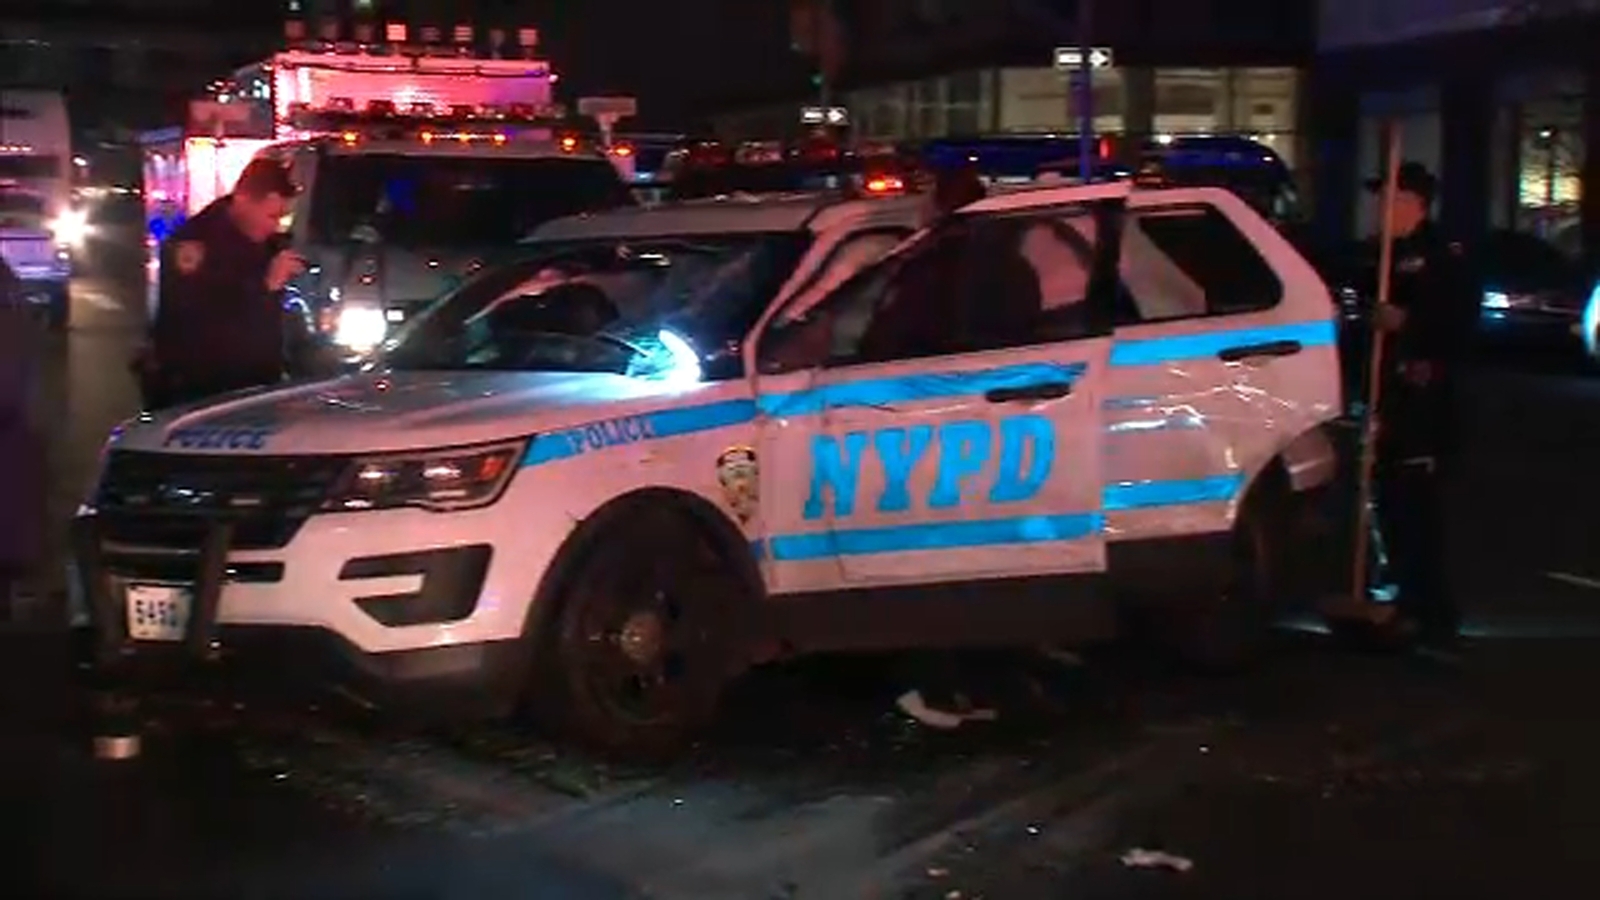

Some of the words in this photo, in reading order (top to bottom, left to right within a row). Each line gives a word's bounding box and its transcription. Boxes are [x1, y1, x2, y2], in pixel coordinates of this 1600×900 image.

[162, 427, 272, 449] POLICE
[566, 414, 653, 453] POLICE
[803, 414, 1055, 519] NYPD
